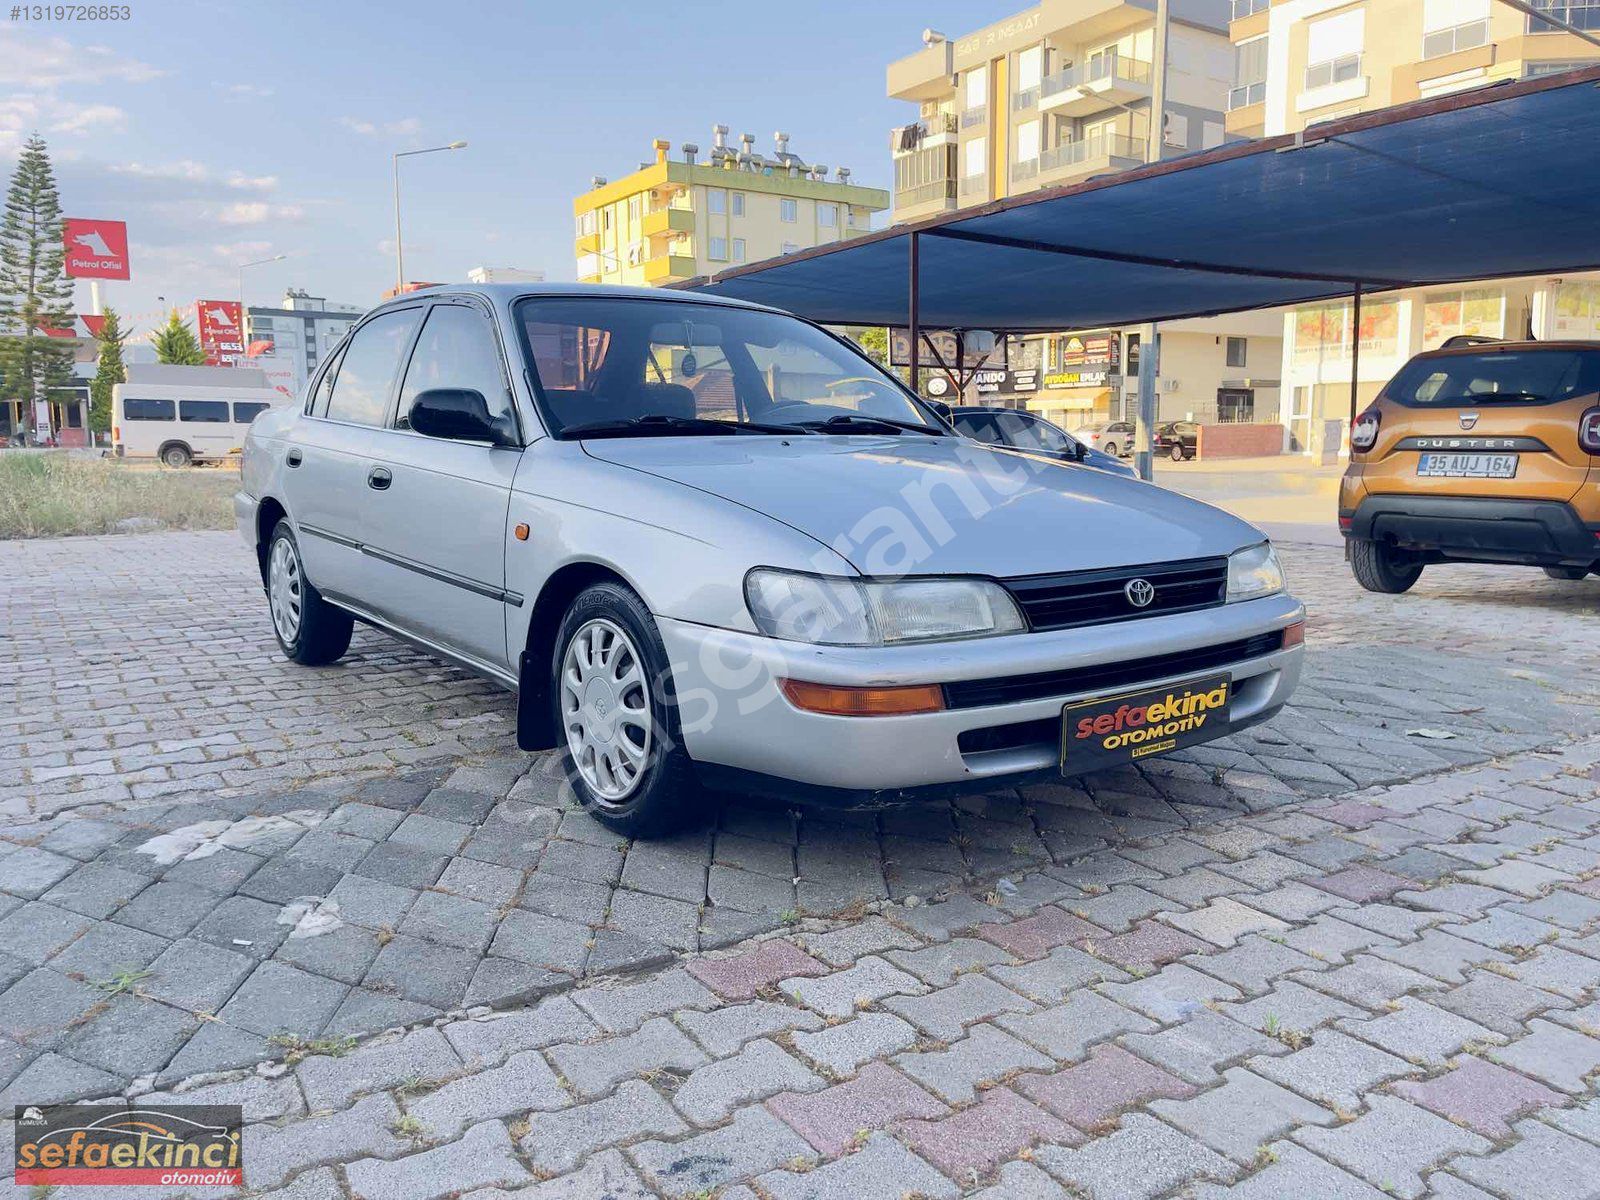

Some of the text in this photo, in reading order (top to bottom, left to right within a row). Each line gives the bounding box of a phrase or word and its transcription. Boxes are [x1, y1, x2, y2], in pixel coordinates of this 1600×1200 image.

[72, 259, 99, 268] Petrol
[1417, 440, 1515, 448] DUSTER
[1429, 456, 1511, 472] 35 AUJ 164
